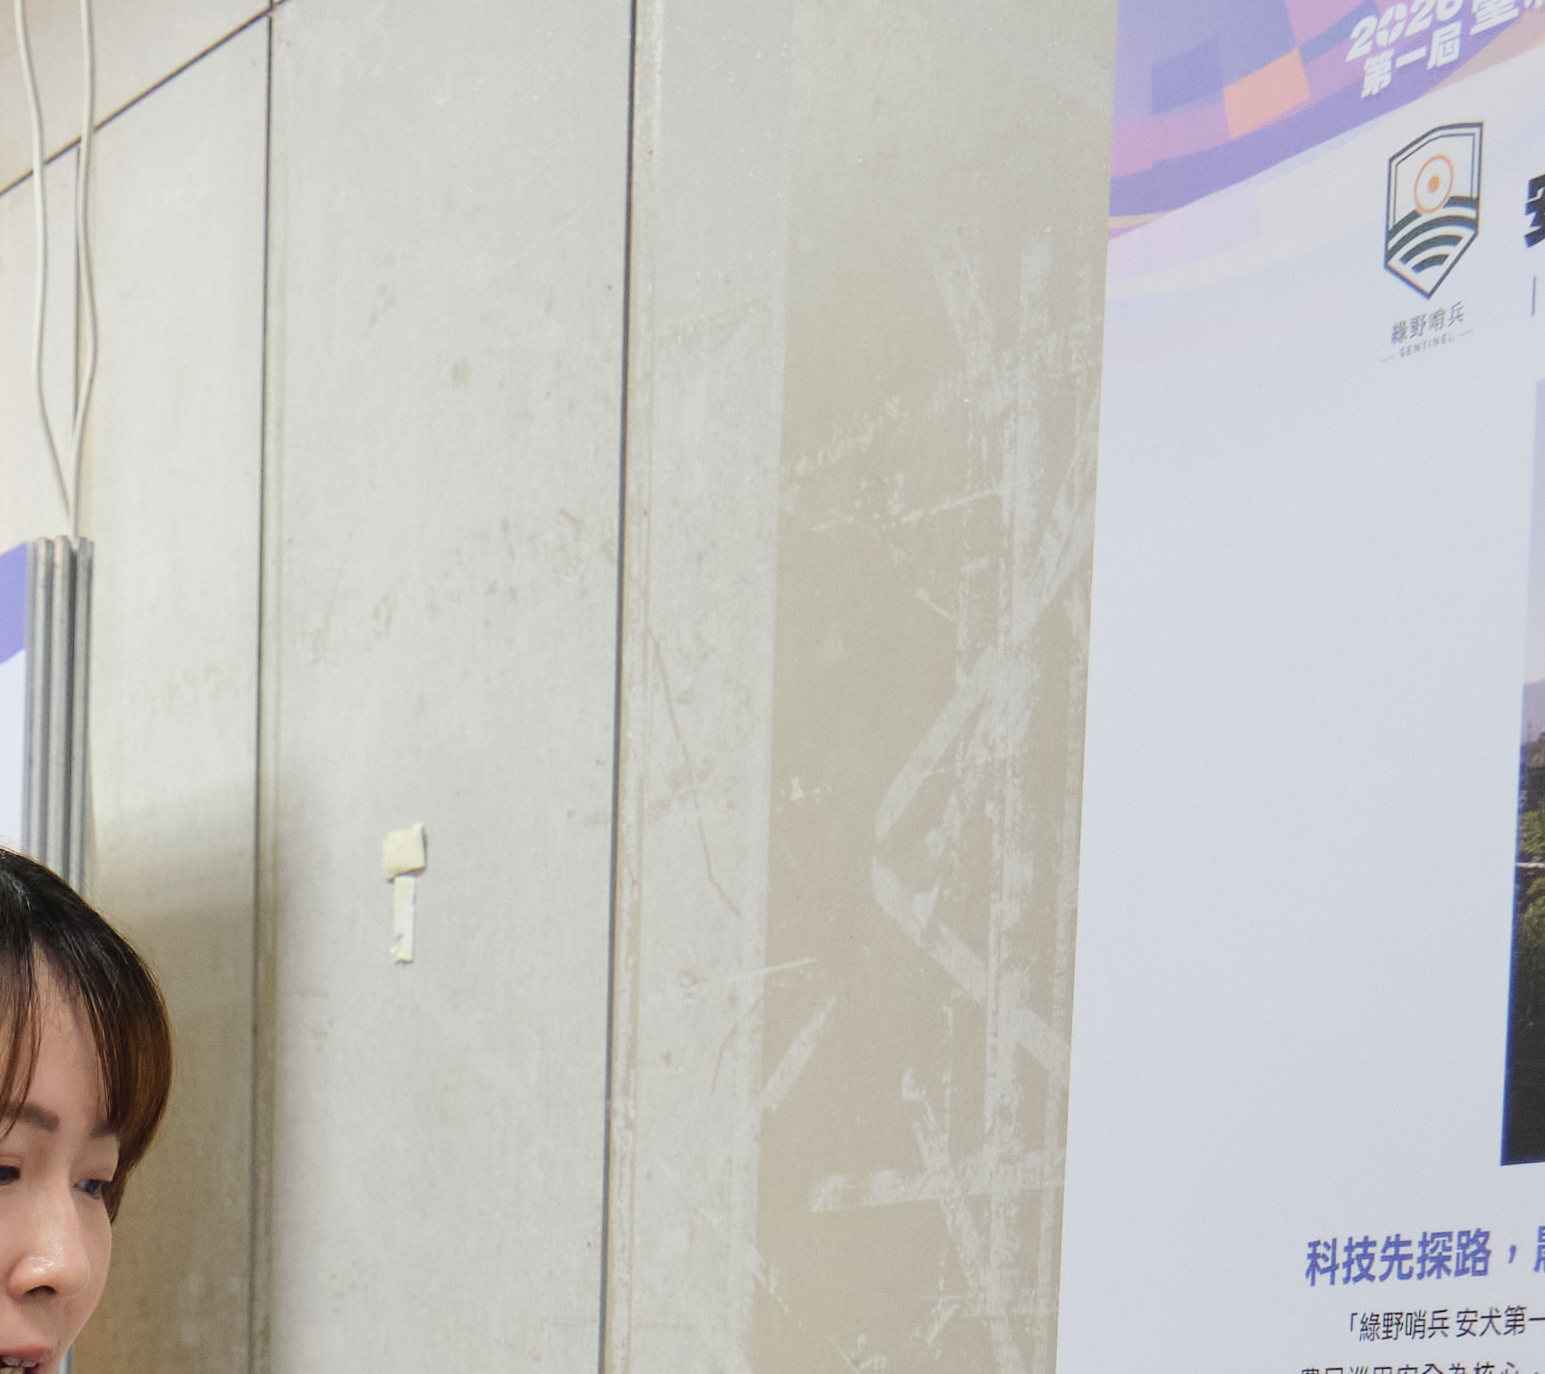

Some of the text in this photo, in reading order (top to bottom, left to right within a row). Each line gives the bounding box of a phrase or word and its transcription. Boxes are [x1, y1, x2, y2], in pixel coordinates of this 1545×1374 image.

[1361, 21, 1462, 98] 第一屆
[1391, 301, 1465, 344] 綠野哨兵
[1399, 332, 1455, 358] SENTINEL
